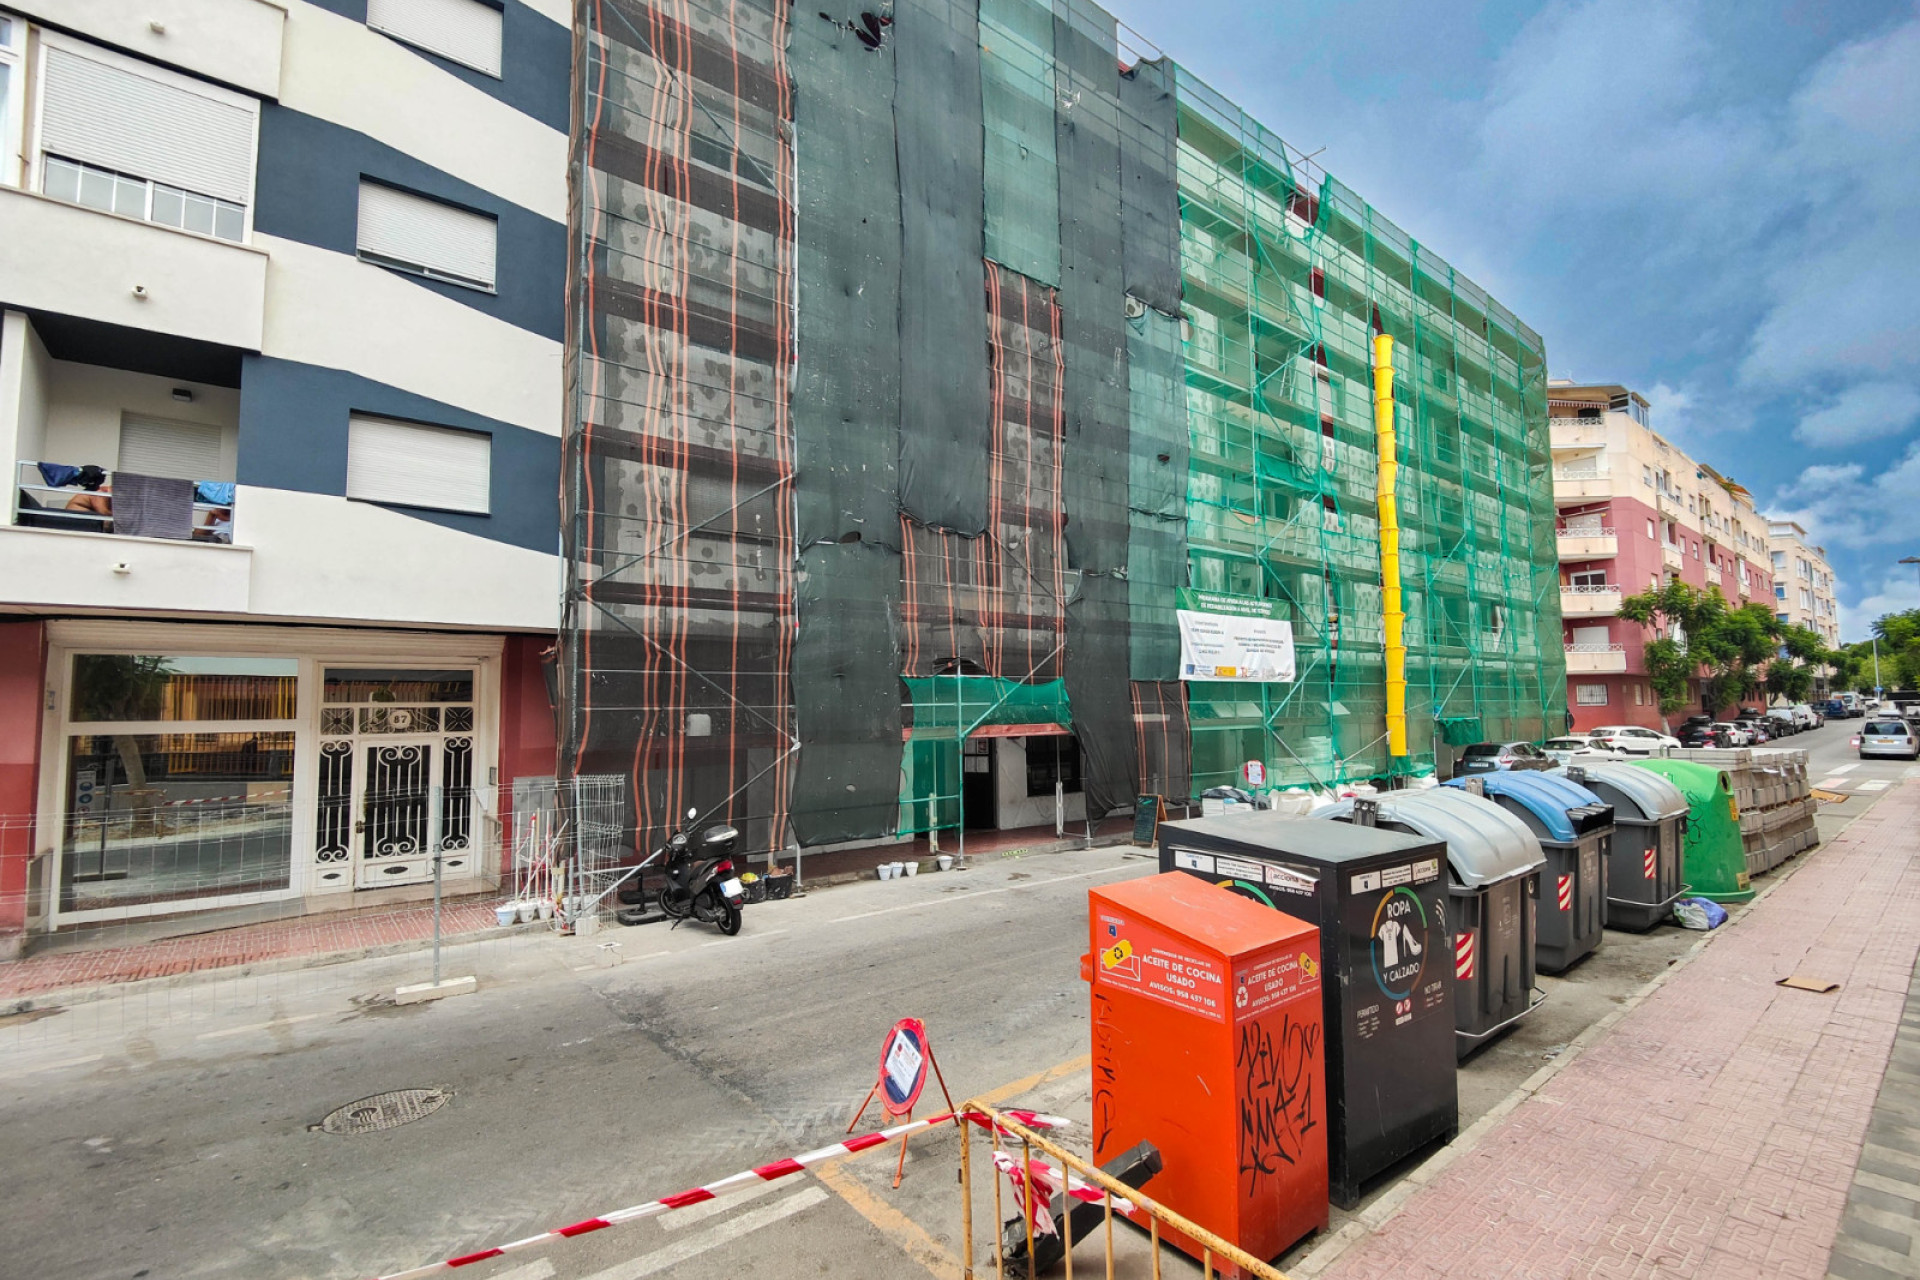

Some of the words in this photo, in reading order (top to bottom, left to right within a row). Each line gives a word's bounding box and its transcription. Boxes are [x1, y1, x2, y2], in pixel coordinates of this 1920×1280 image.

[394, 715, 408, 724] 87
[1387, 899, 1411, 919] ROPA
[1142, 954, 1170, 970] ACEITE
[1172, 962, 1184, 974] DE
[1186, 966, 1222, 984] COCINA
[1248, 970, 1267, 985] ACEITE
[1268, 968, 1276, 978] DE
[1277, 960, 1298, 974] COCINA
[1383, 972, 1388, 984] Y
[1389, 962, 1420, 982] CALZADO
[1149, 981, 1176, 995] AVISOS:
[1166, 973, 1196, 989] USADO
[1265, 977, 1284, 992] USADO
